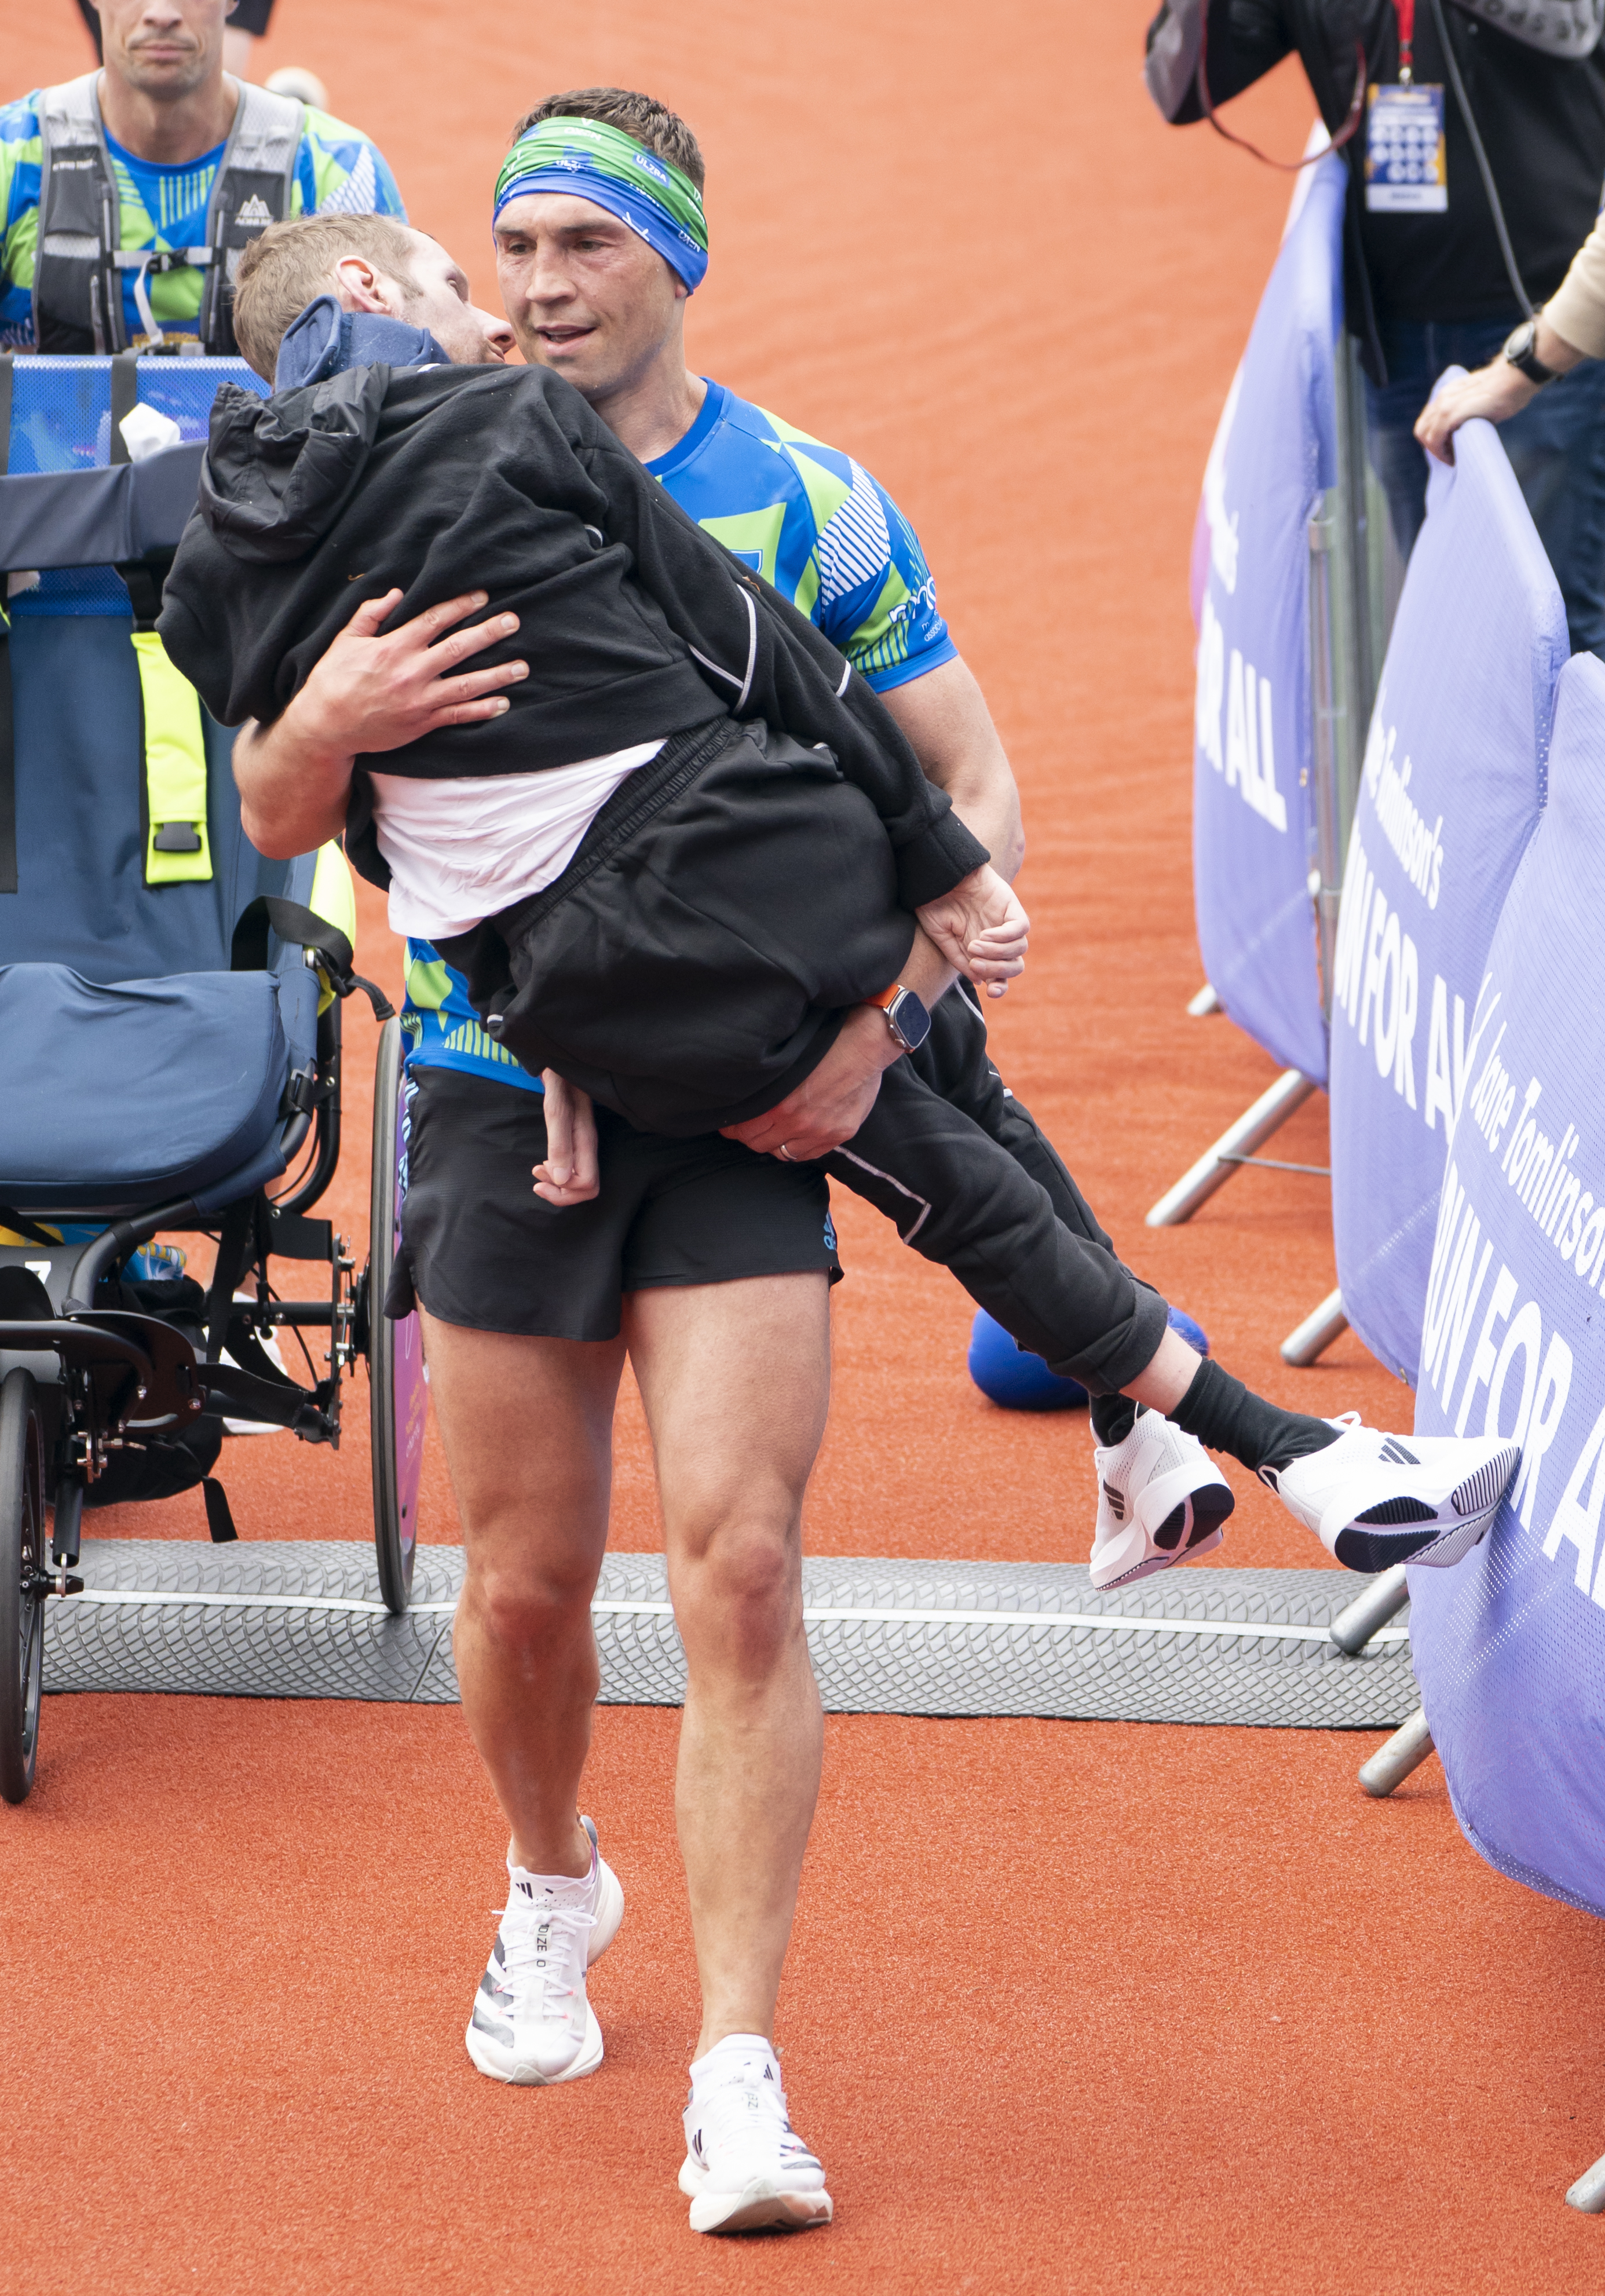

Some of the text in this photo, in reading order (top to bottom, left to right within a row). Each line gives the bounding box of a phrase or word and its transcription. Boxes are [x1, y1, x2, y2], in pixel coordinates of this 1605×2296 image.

[1225, 648, 1287, 832] ALL
[1359, 887, 1418, 1110] FOR
[1425, 974, 1464, 1146] AL
[1470, 1021, 1516, 1153] Jane
[1456, 1263, 1573, 1533] FOR
